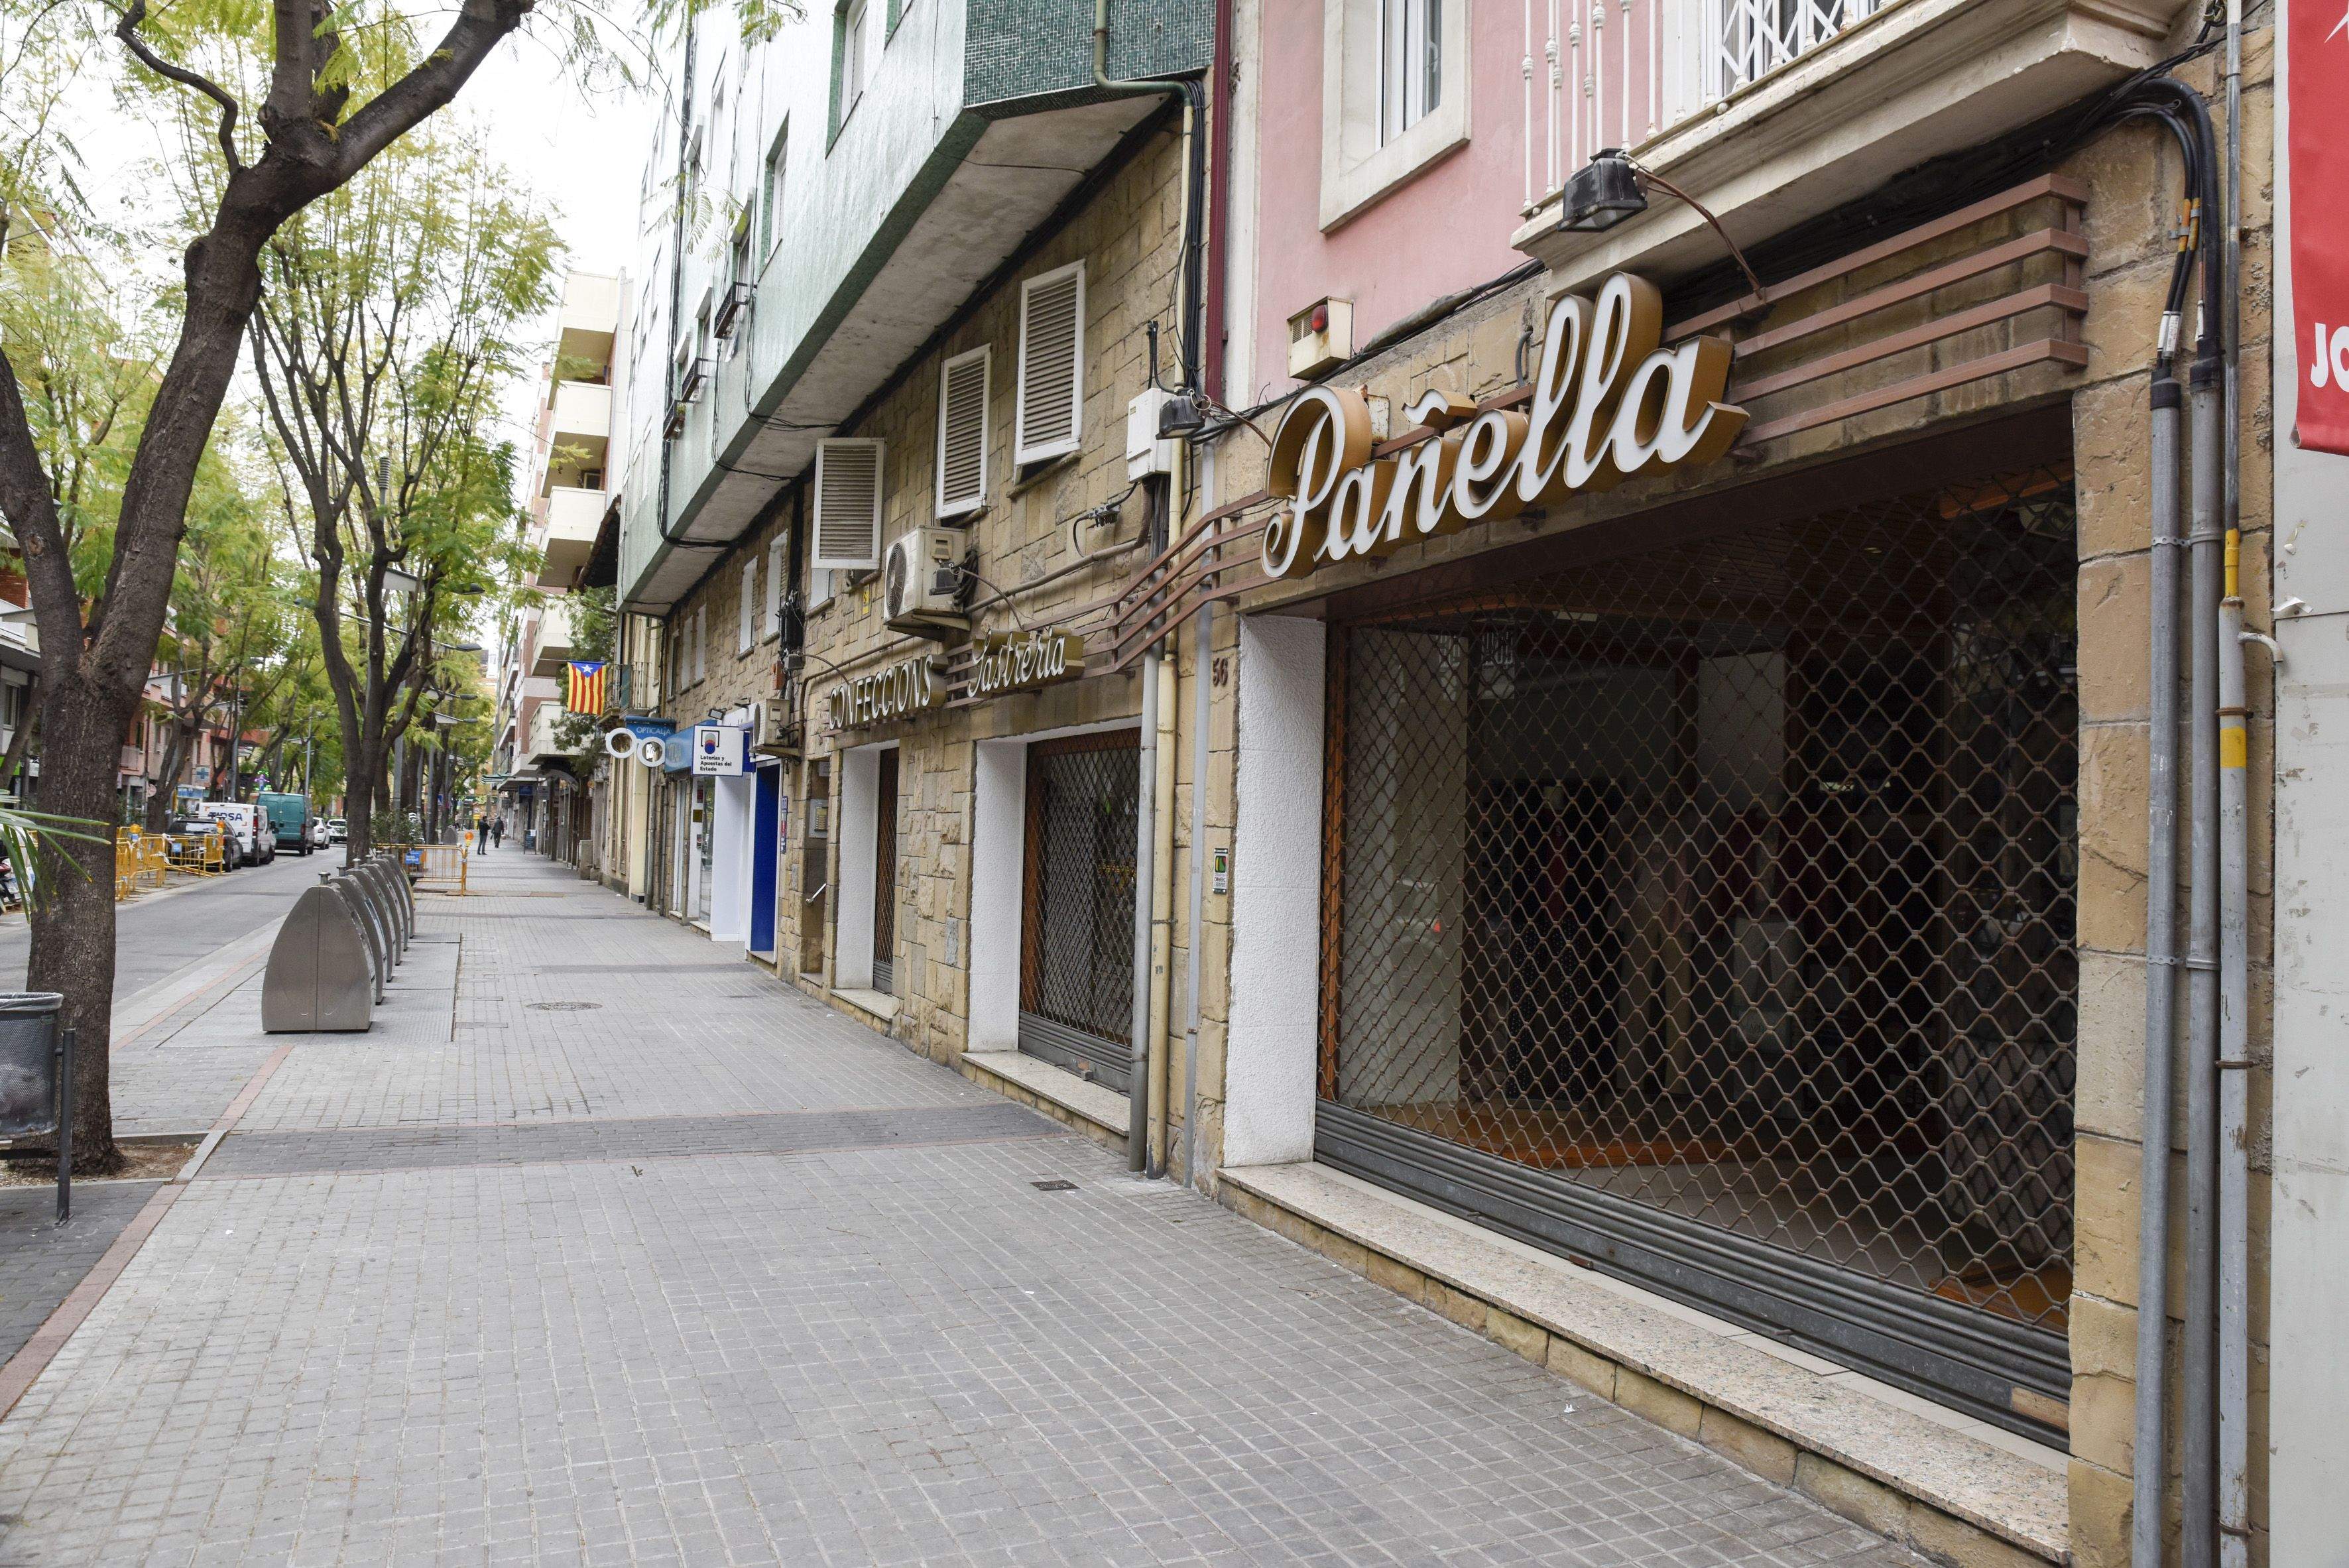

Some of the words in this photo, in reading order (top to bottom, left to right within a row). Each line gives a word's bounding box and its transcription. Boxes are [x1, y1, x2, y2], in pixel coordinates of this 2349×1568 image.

[1261, 271, 1736, 579] Pañella
[829, 654, 936, 730] CONFECCIONS
[1213, 657, 1228, 687] 56
